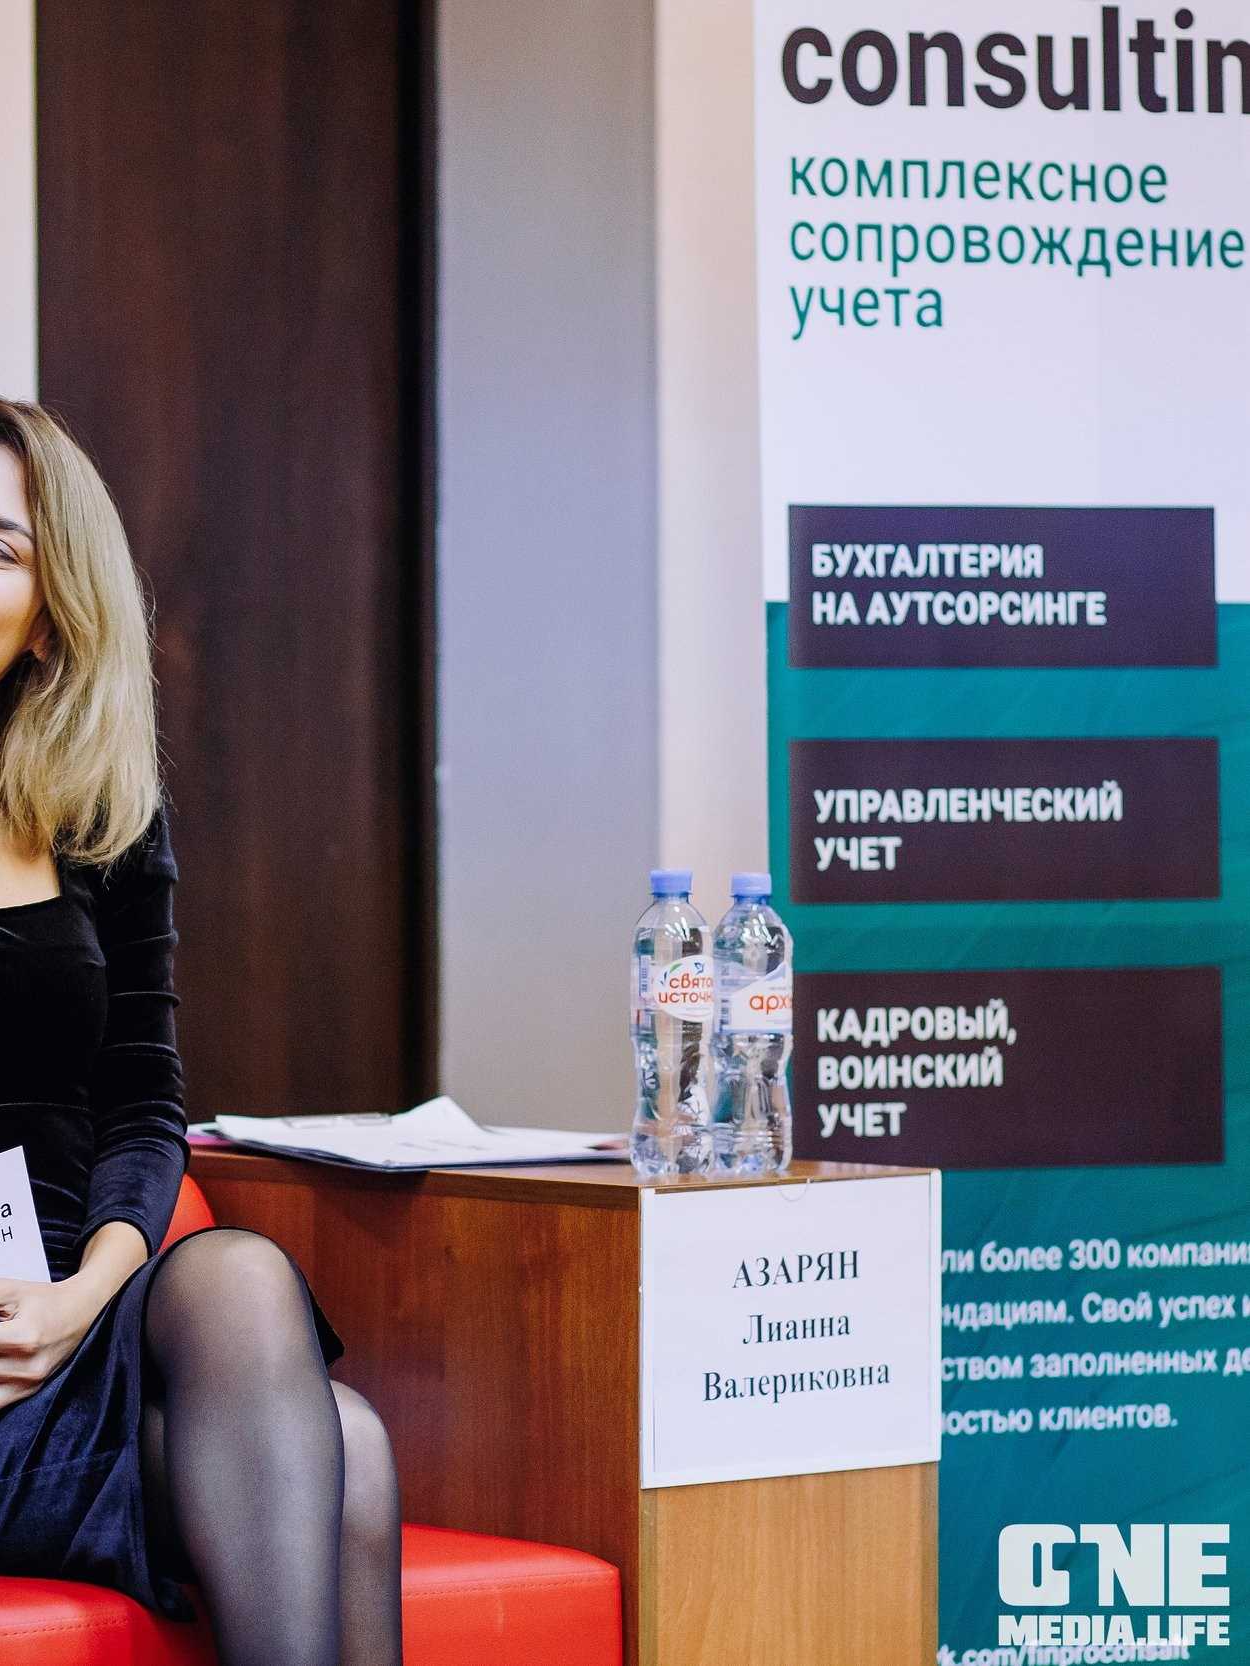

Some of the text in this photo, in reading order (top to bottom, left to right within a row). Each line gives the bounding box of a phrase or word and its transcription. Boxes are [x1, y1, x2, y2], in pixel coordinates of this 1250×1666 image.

[781, 5, 1250, 115] consultin
[790, 156, 1168, 204] комплексное
[789, 221, 1246, 278] сопровождение
[789, 285, 944, 341] учета
[811, 542, 1045, 579] БУХГАЛТЕРИЯ
[811, 590, 1109, 627] НА АУТСОРСИНГЕ
[812, 780, 1124, 824] УПРАВЛЕНЧЕСКИЙ
[812, 836, 903, 872] УЧЕТ
[816, 999, 1018, 1045] КАДРОВЫЙ,
[817, 1045, 1004, 1090] ВОИНСКИЙ
[817, 1102, 907, 1138] УЧЕТ
[732, 1250, 859, 1288] АЗАРЯН
[979, 1240, 1063, 1273] более
[1068, 1238, 1122, 1270] 300
[1126, 1241, 1250, 1269] компани
[743, 1314, 850, 1345] Лианна
[942, 1299, 1075, 1332] ндациям.
[1081, 1291, 1153, 1324] Свой
[1158, 1294, 1236, 1329] успех
[1029, 1348, 1218, 1379] заполненных
[702, 1363, 890, 1404] Валериковна
[942, 1403, 1178, 1436] остью клиентов.
